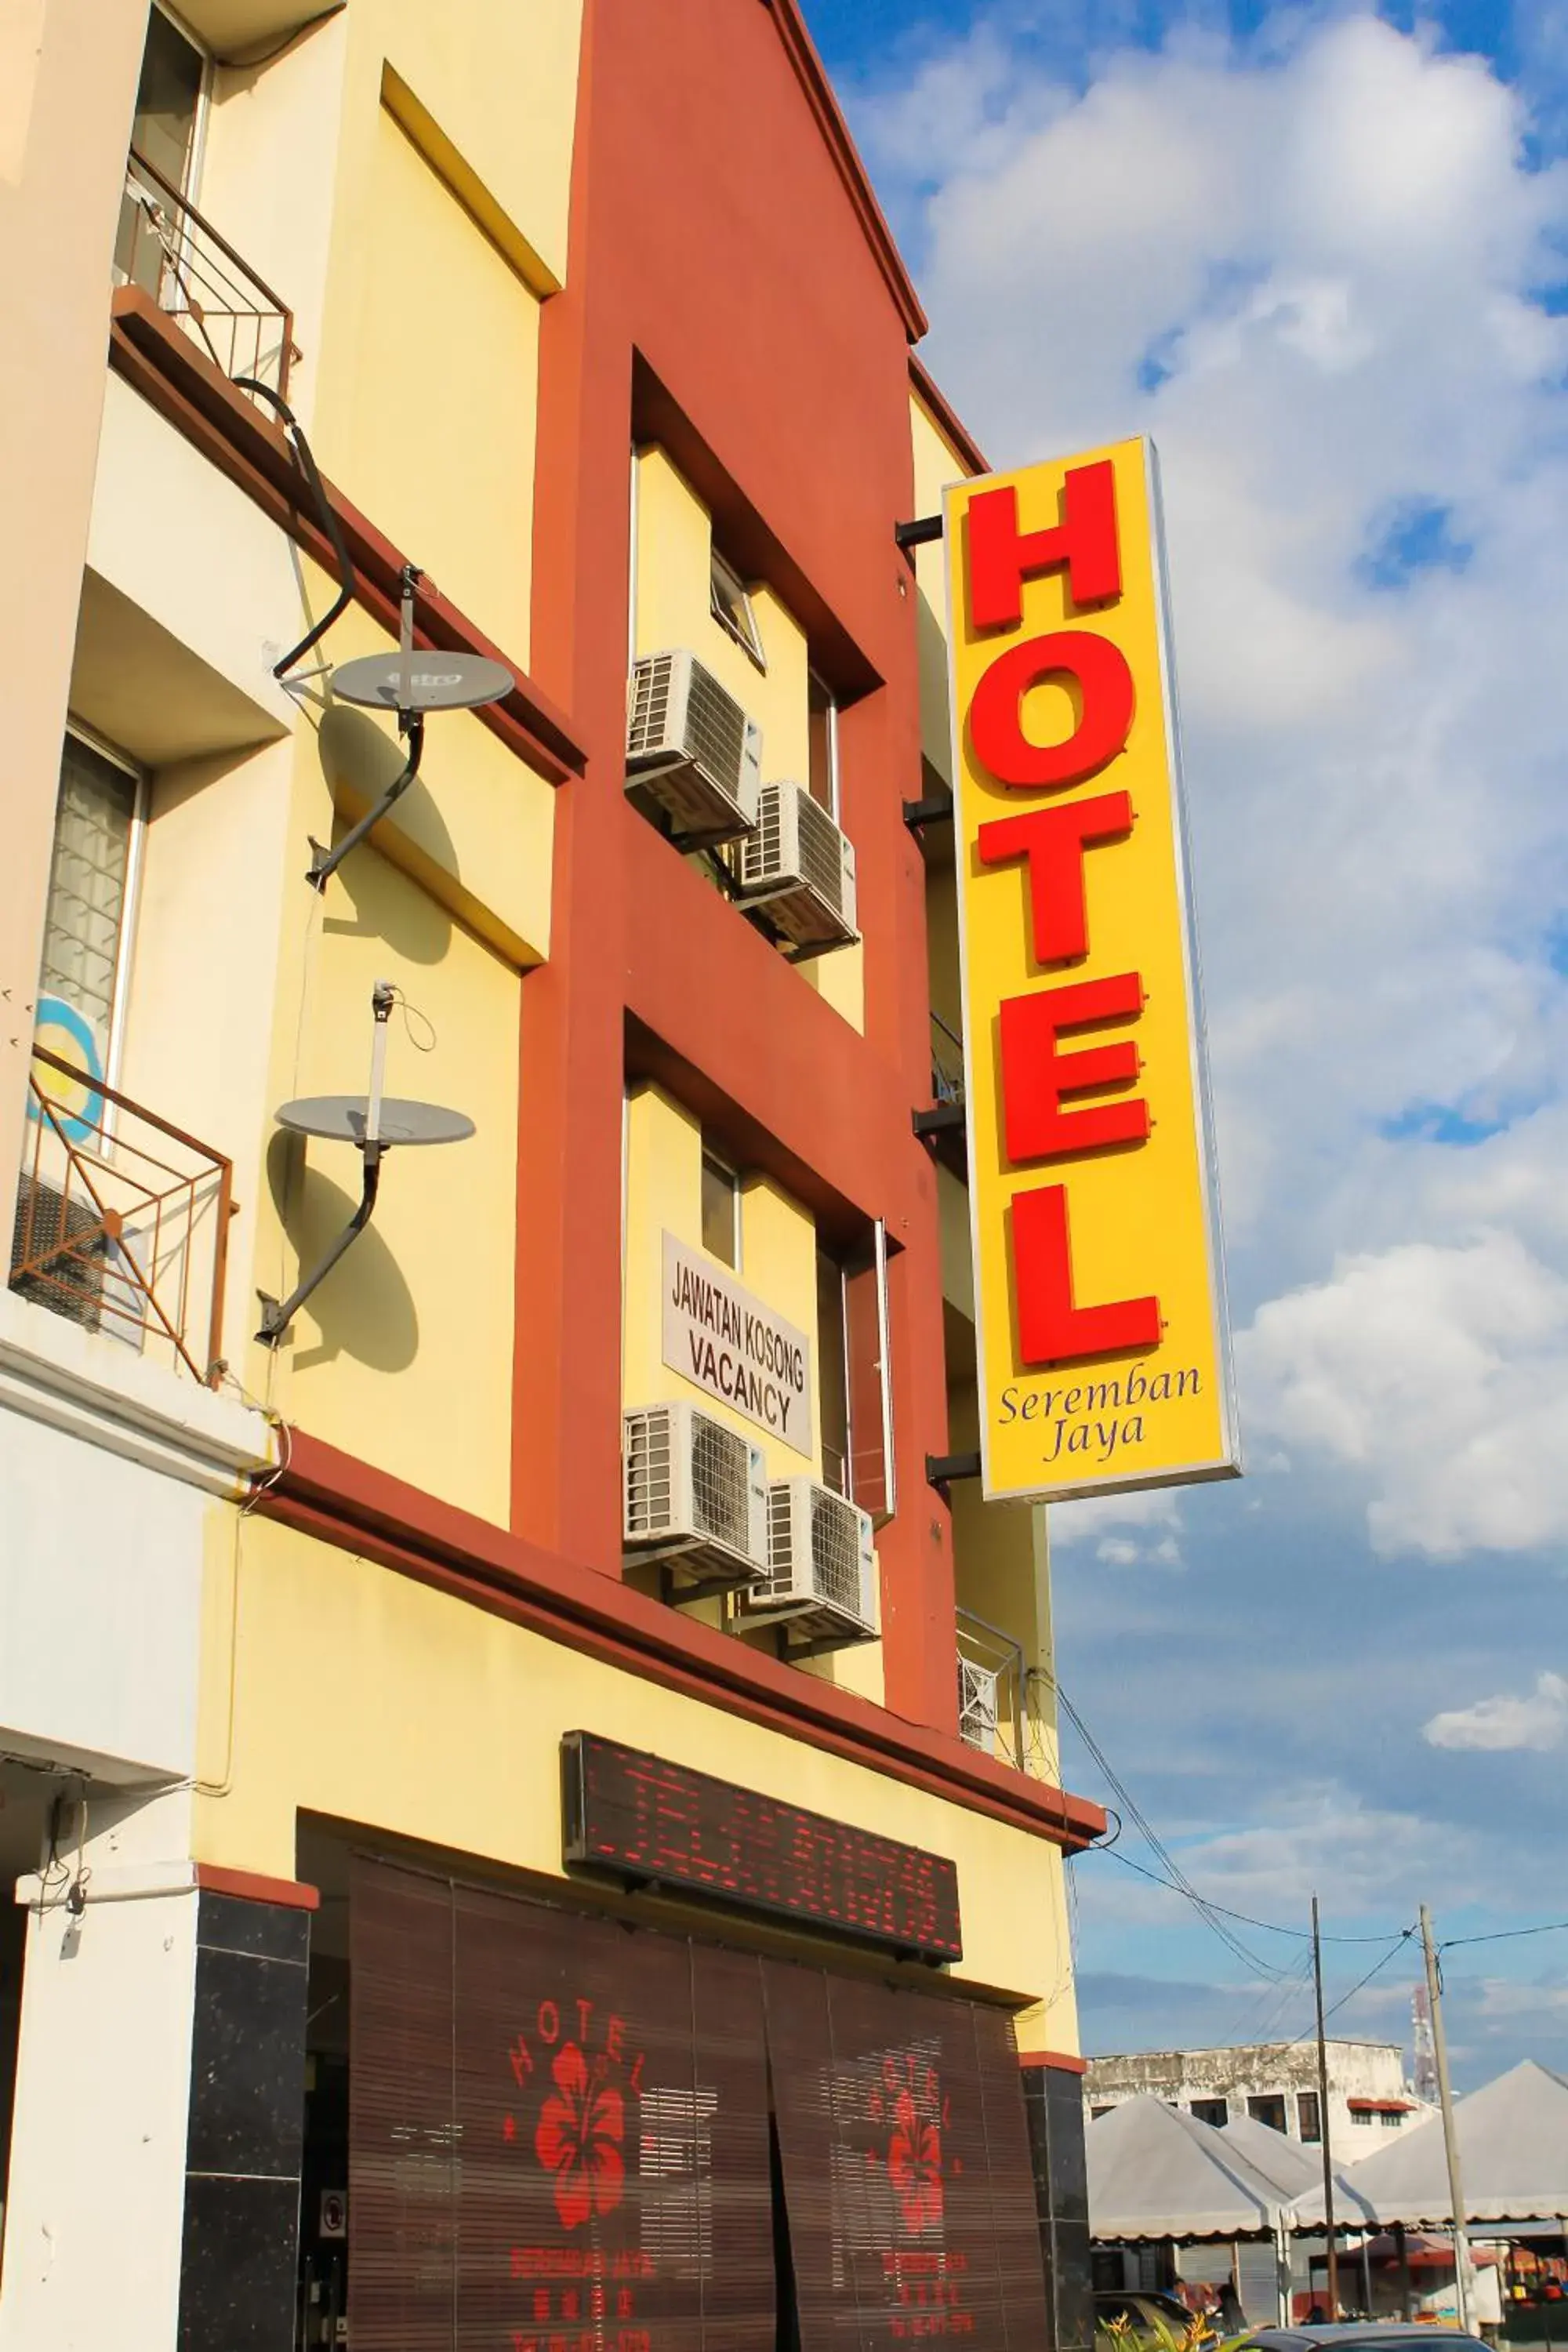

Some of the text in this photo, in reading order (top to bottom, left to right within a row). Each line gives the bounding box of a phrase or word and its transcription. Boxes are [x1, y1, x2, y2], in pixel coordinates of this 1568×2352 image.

[967, 459, 1165, 1367] HOTEL
[672, 1261, 804, 1393] JAWATAN KOSONG
[688, 1329, 791, 1434] VACANCY
[998, 1363, 1203, 1425] Seremban
[1042, 1415, 1148, 1462] Jaya
[509, 1998, 645, 2098] HOTEL
